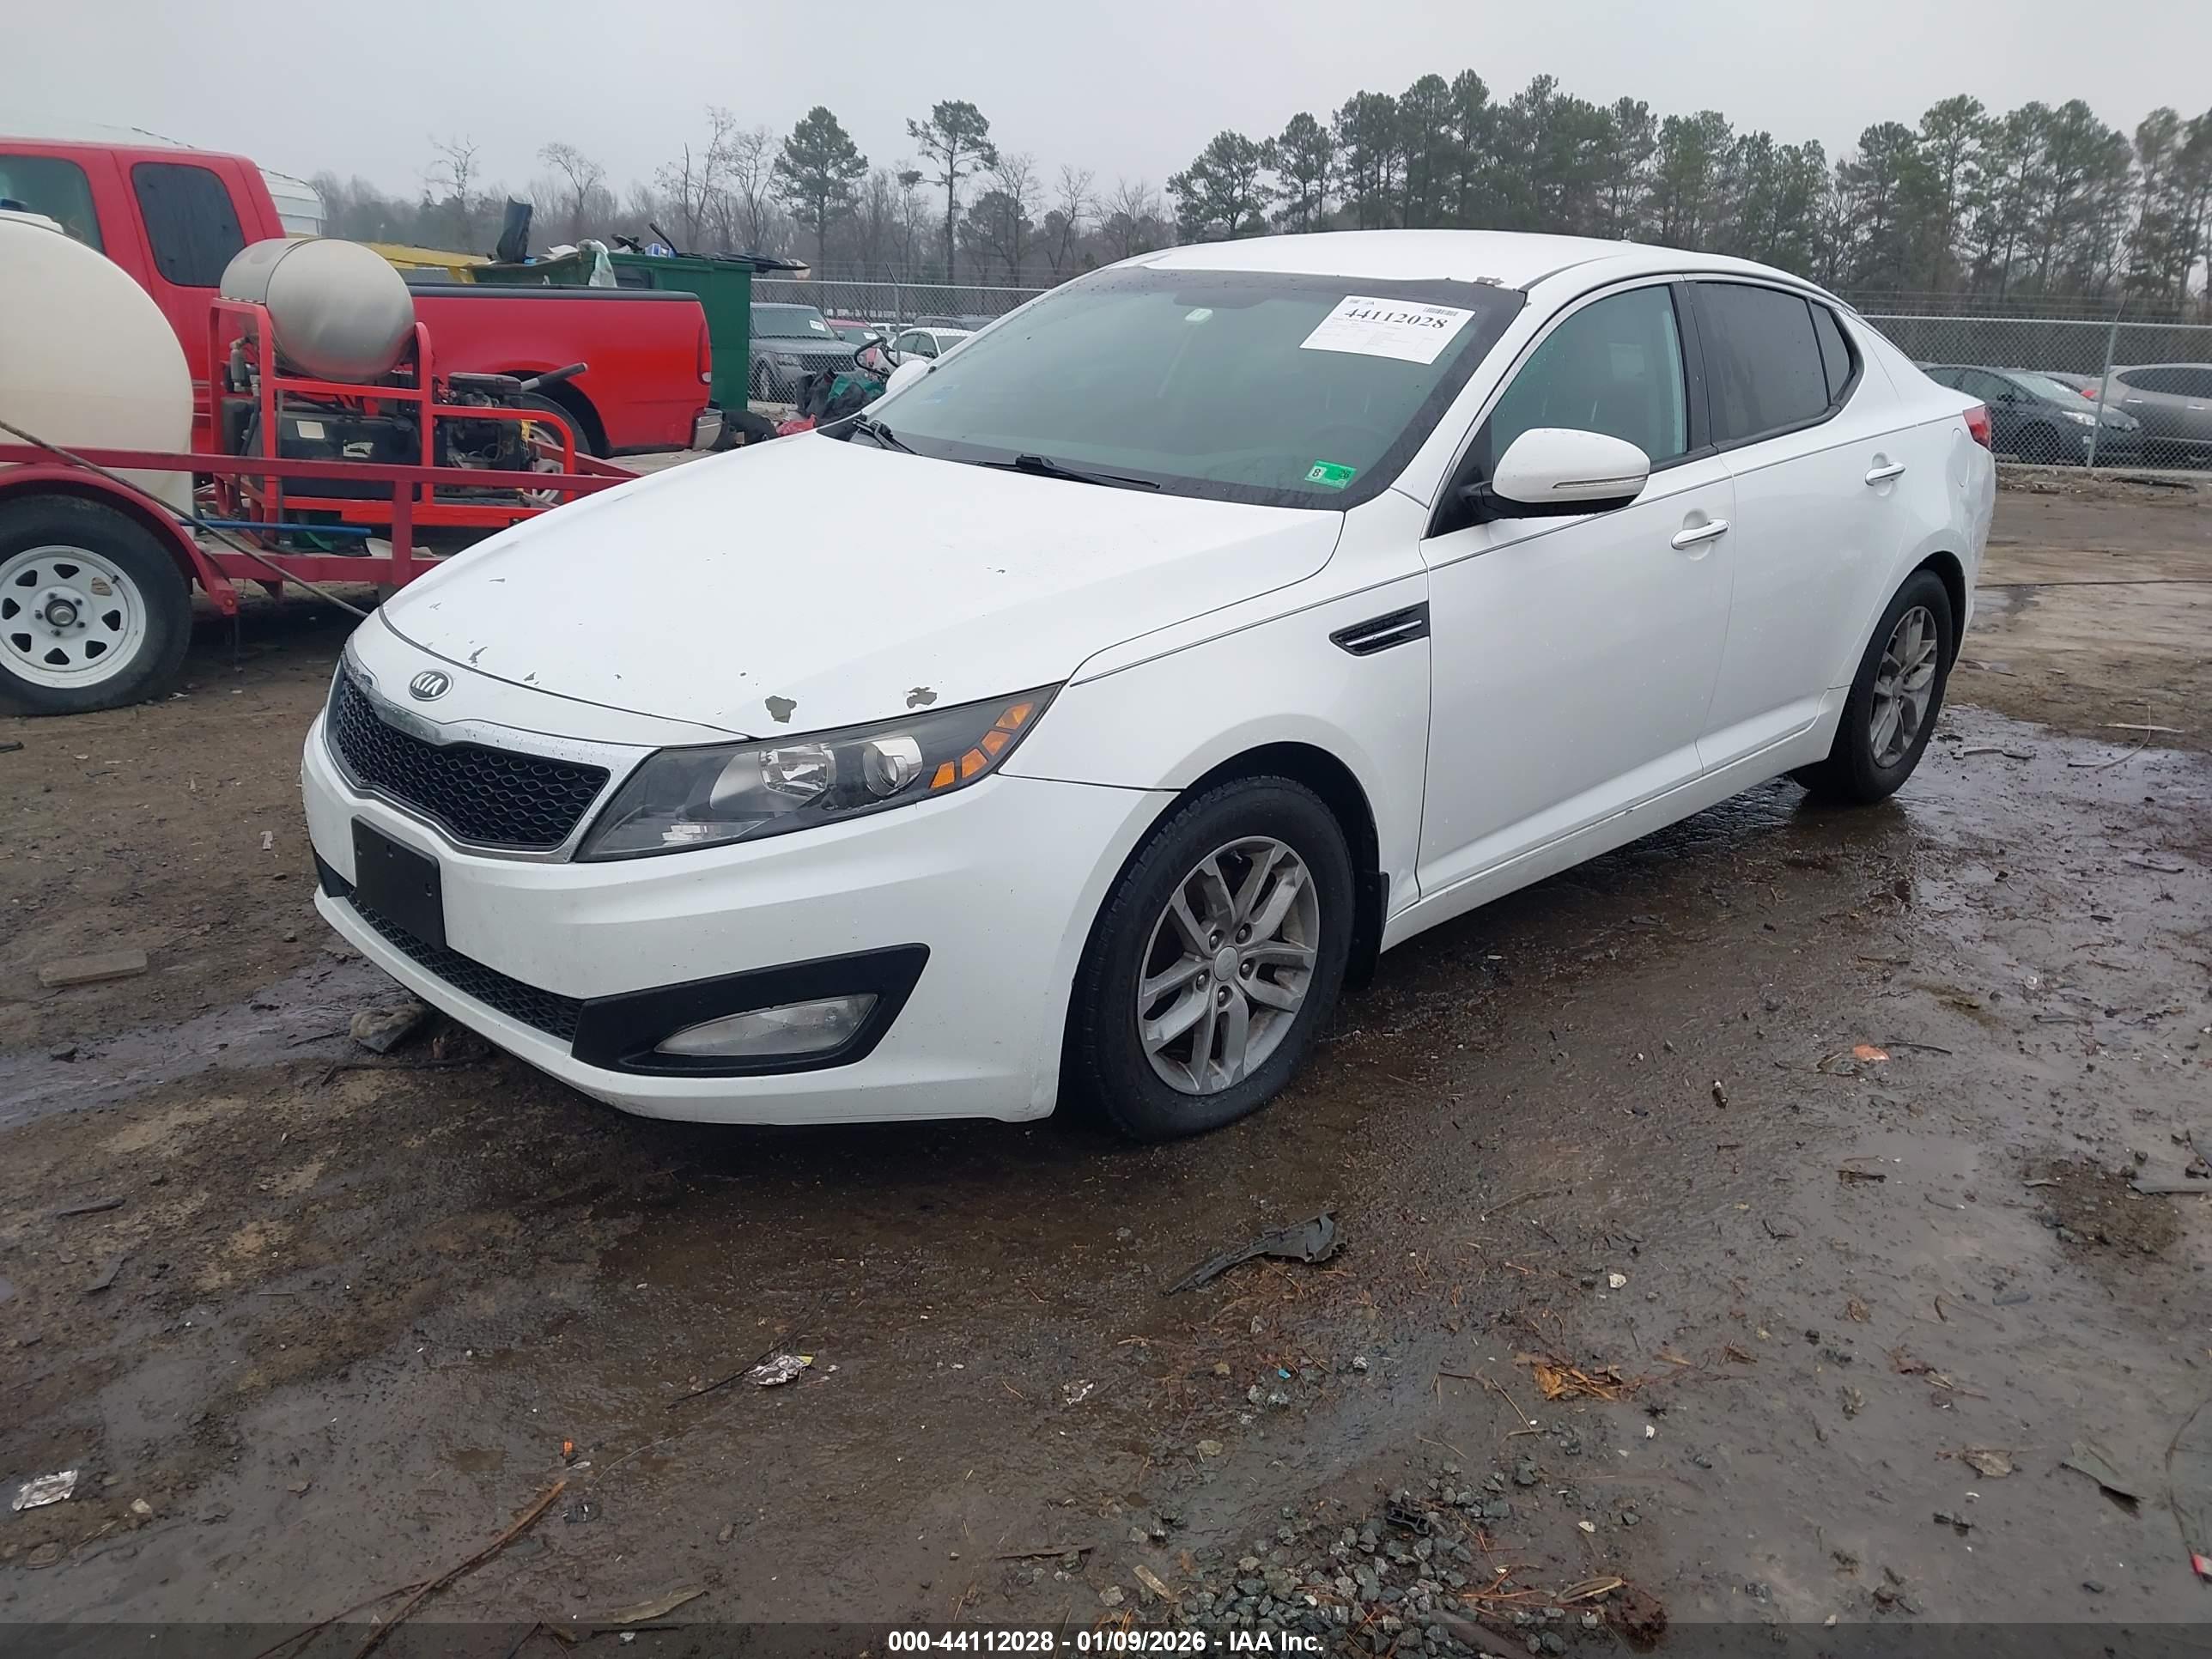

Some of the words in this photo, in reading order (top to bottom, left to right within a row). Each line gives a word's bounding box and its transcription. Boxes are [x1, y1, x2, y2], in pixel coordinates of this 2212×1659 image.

[1344, 308, 1449, 329] 44112028
[1311, 468, 1322, 477] 8
[411, 672, 445, 696] KIA
